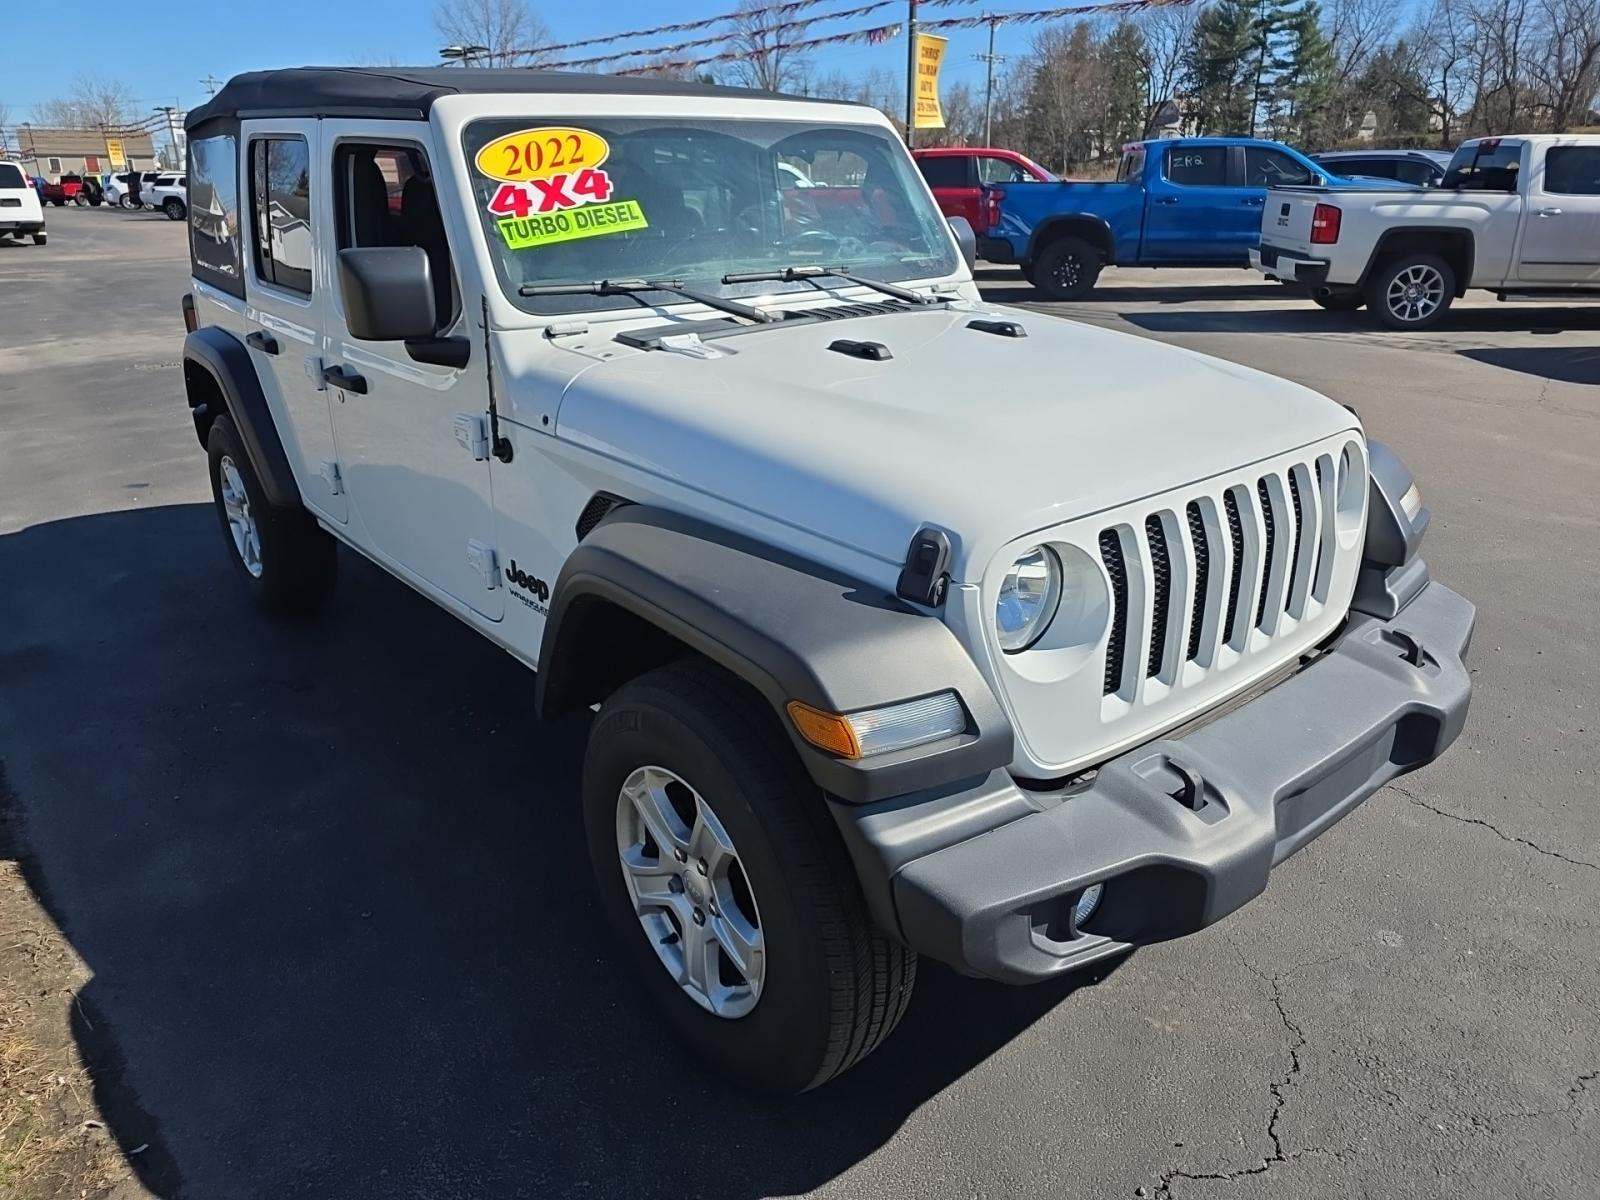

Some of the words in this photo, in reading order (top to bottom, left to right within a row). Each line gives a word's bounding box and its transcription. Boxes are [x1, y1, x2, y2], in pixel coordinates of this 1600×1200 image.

[502, 134, 585, 176] 2022
[1173, 155, 1205, 168] ZR2
[490, 169, 612, 218] 4X4
[501, 215, 571, 241] TURBO
[575, 203, 640, 230] DIESEL
[505, 559, 550, 603] Jeep
